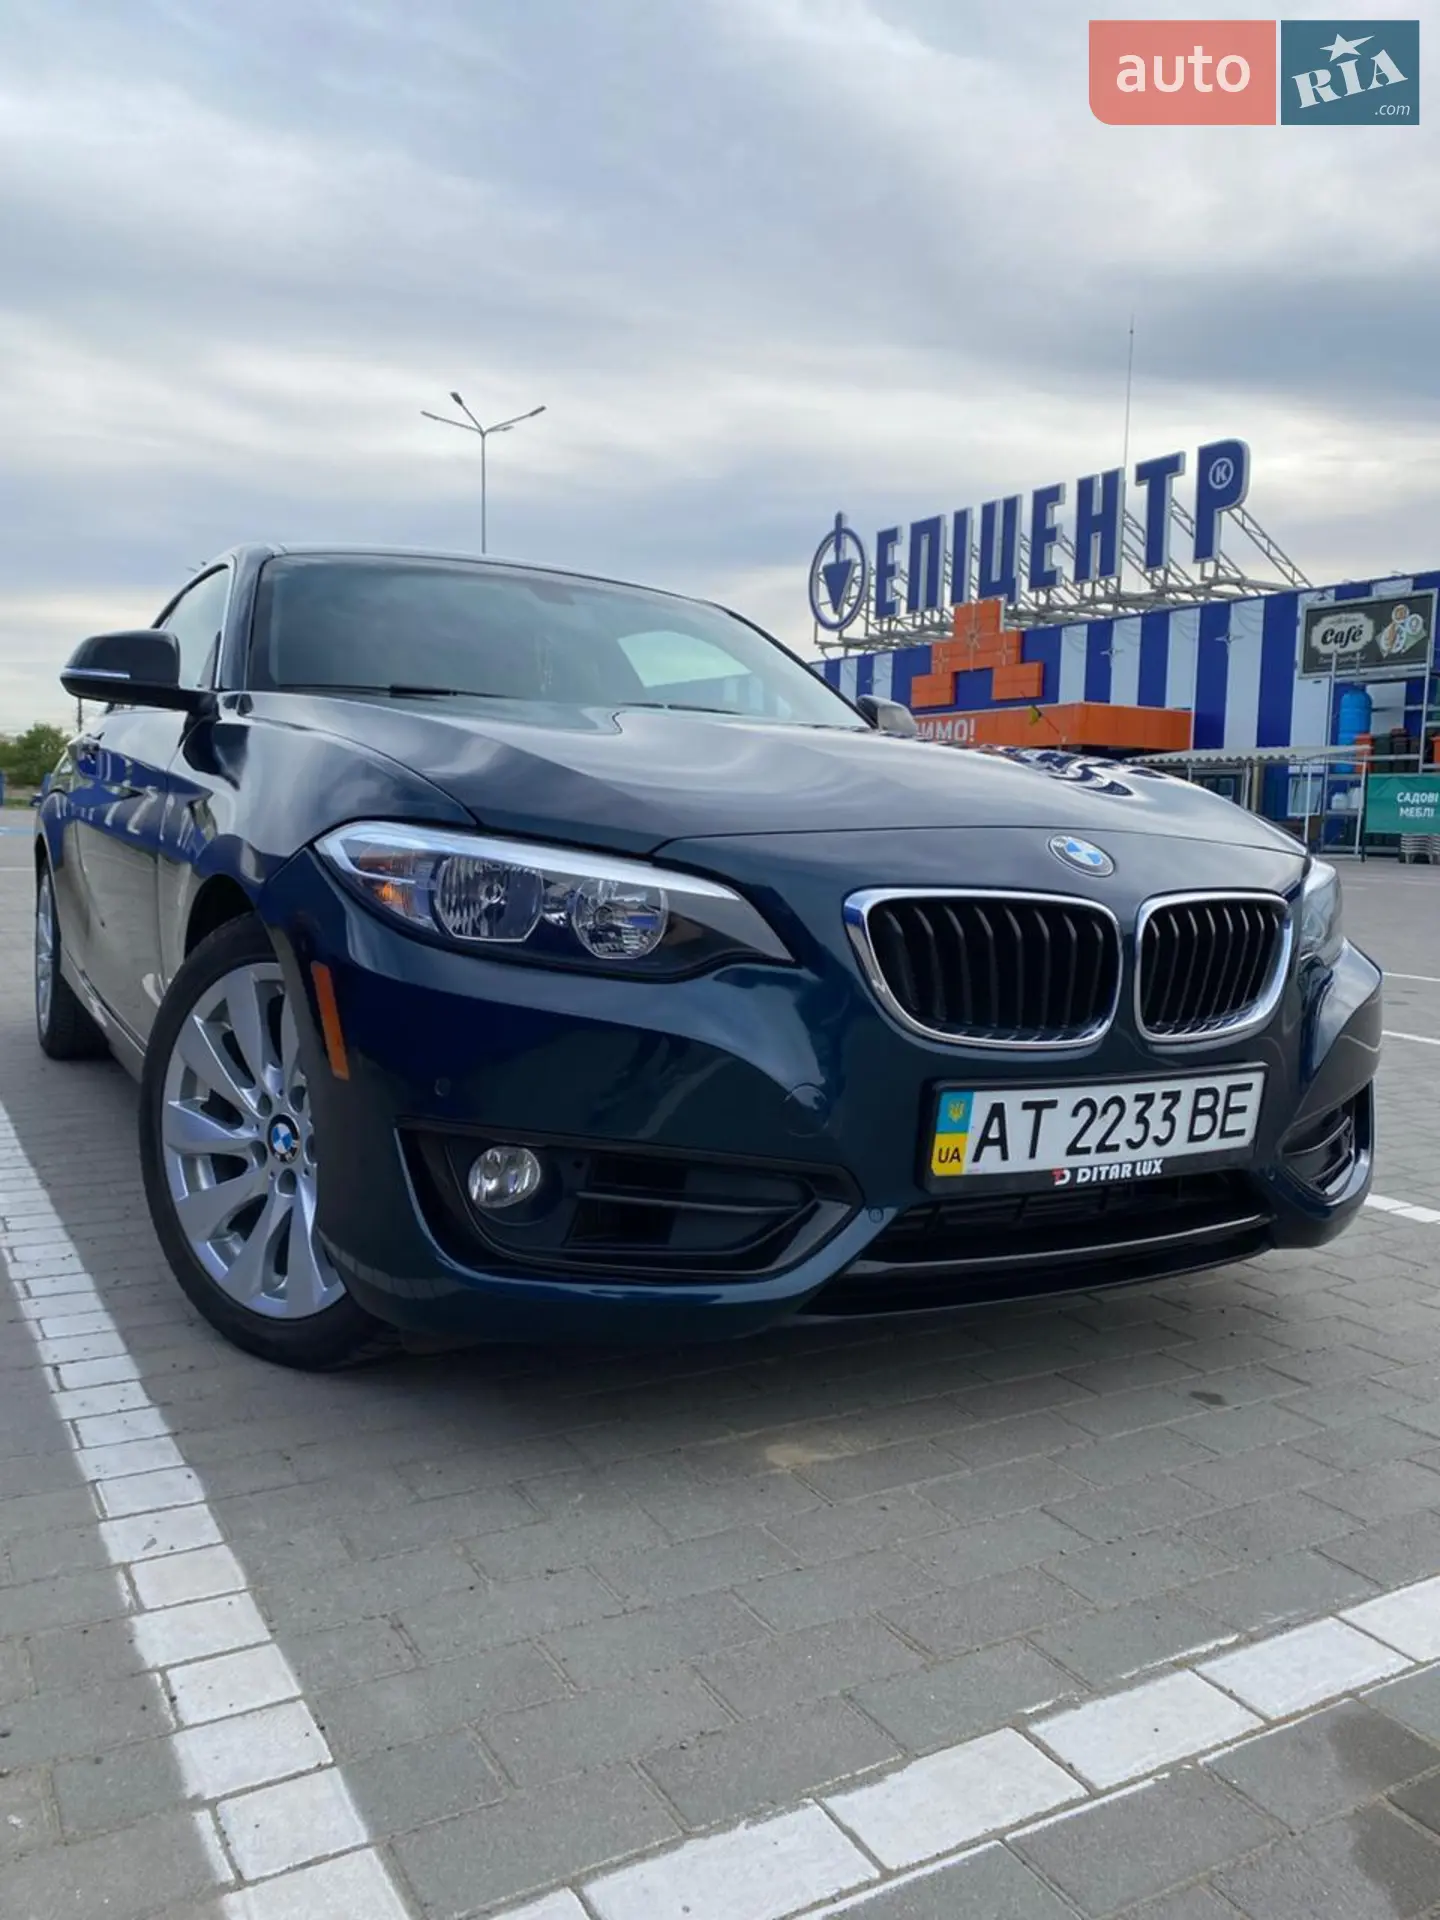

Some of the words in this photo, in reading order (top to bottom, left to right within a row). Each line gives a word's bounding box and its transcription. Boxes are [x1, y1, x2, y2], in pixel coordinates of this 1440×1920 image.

[875, 438, 1251, 620] ЕПІЦЕНТР
[1321, 624, 1364, 649] Café
[1397, 791, 1439, 805] САДОВІ
[1400, 806, 1436, 817] МЕБЛІ
[972, 1099, 1058, 1164] AT
[1065, 1089, 1182, 1157] 2233
[1187, 1082, 1254, 1144] BE
[937, 1145, 962, 1164] UA
[1076, 1163, 1133, 1184] DITAR
[1135, 1158, 1164, 1176] LUX
